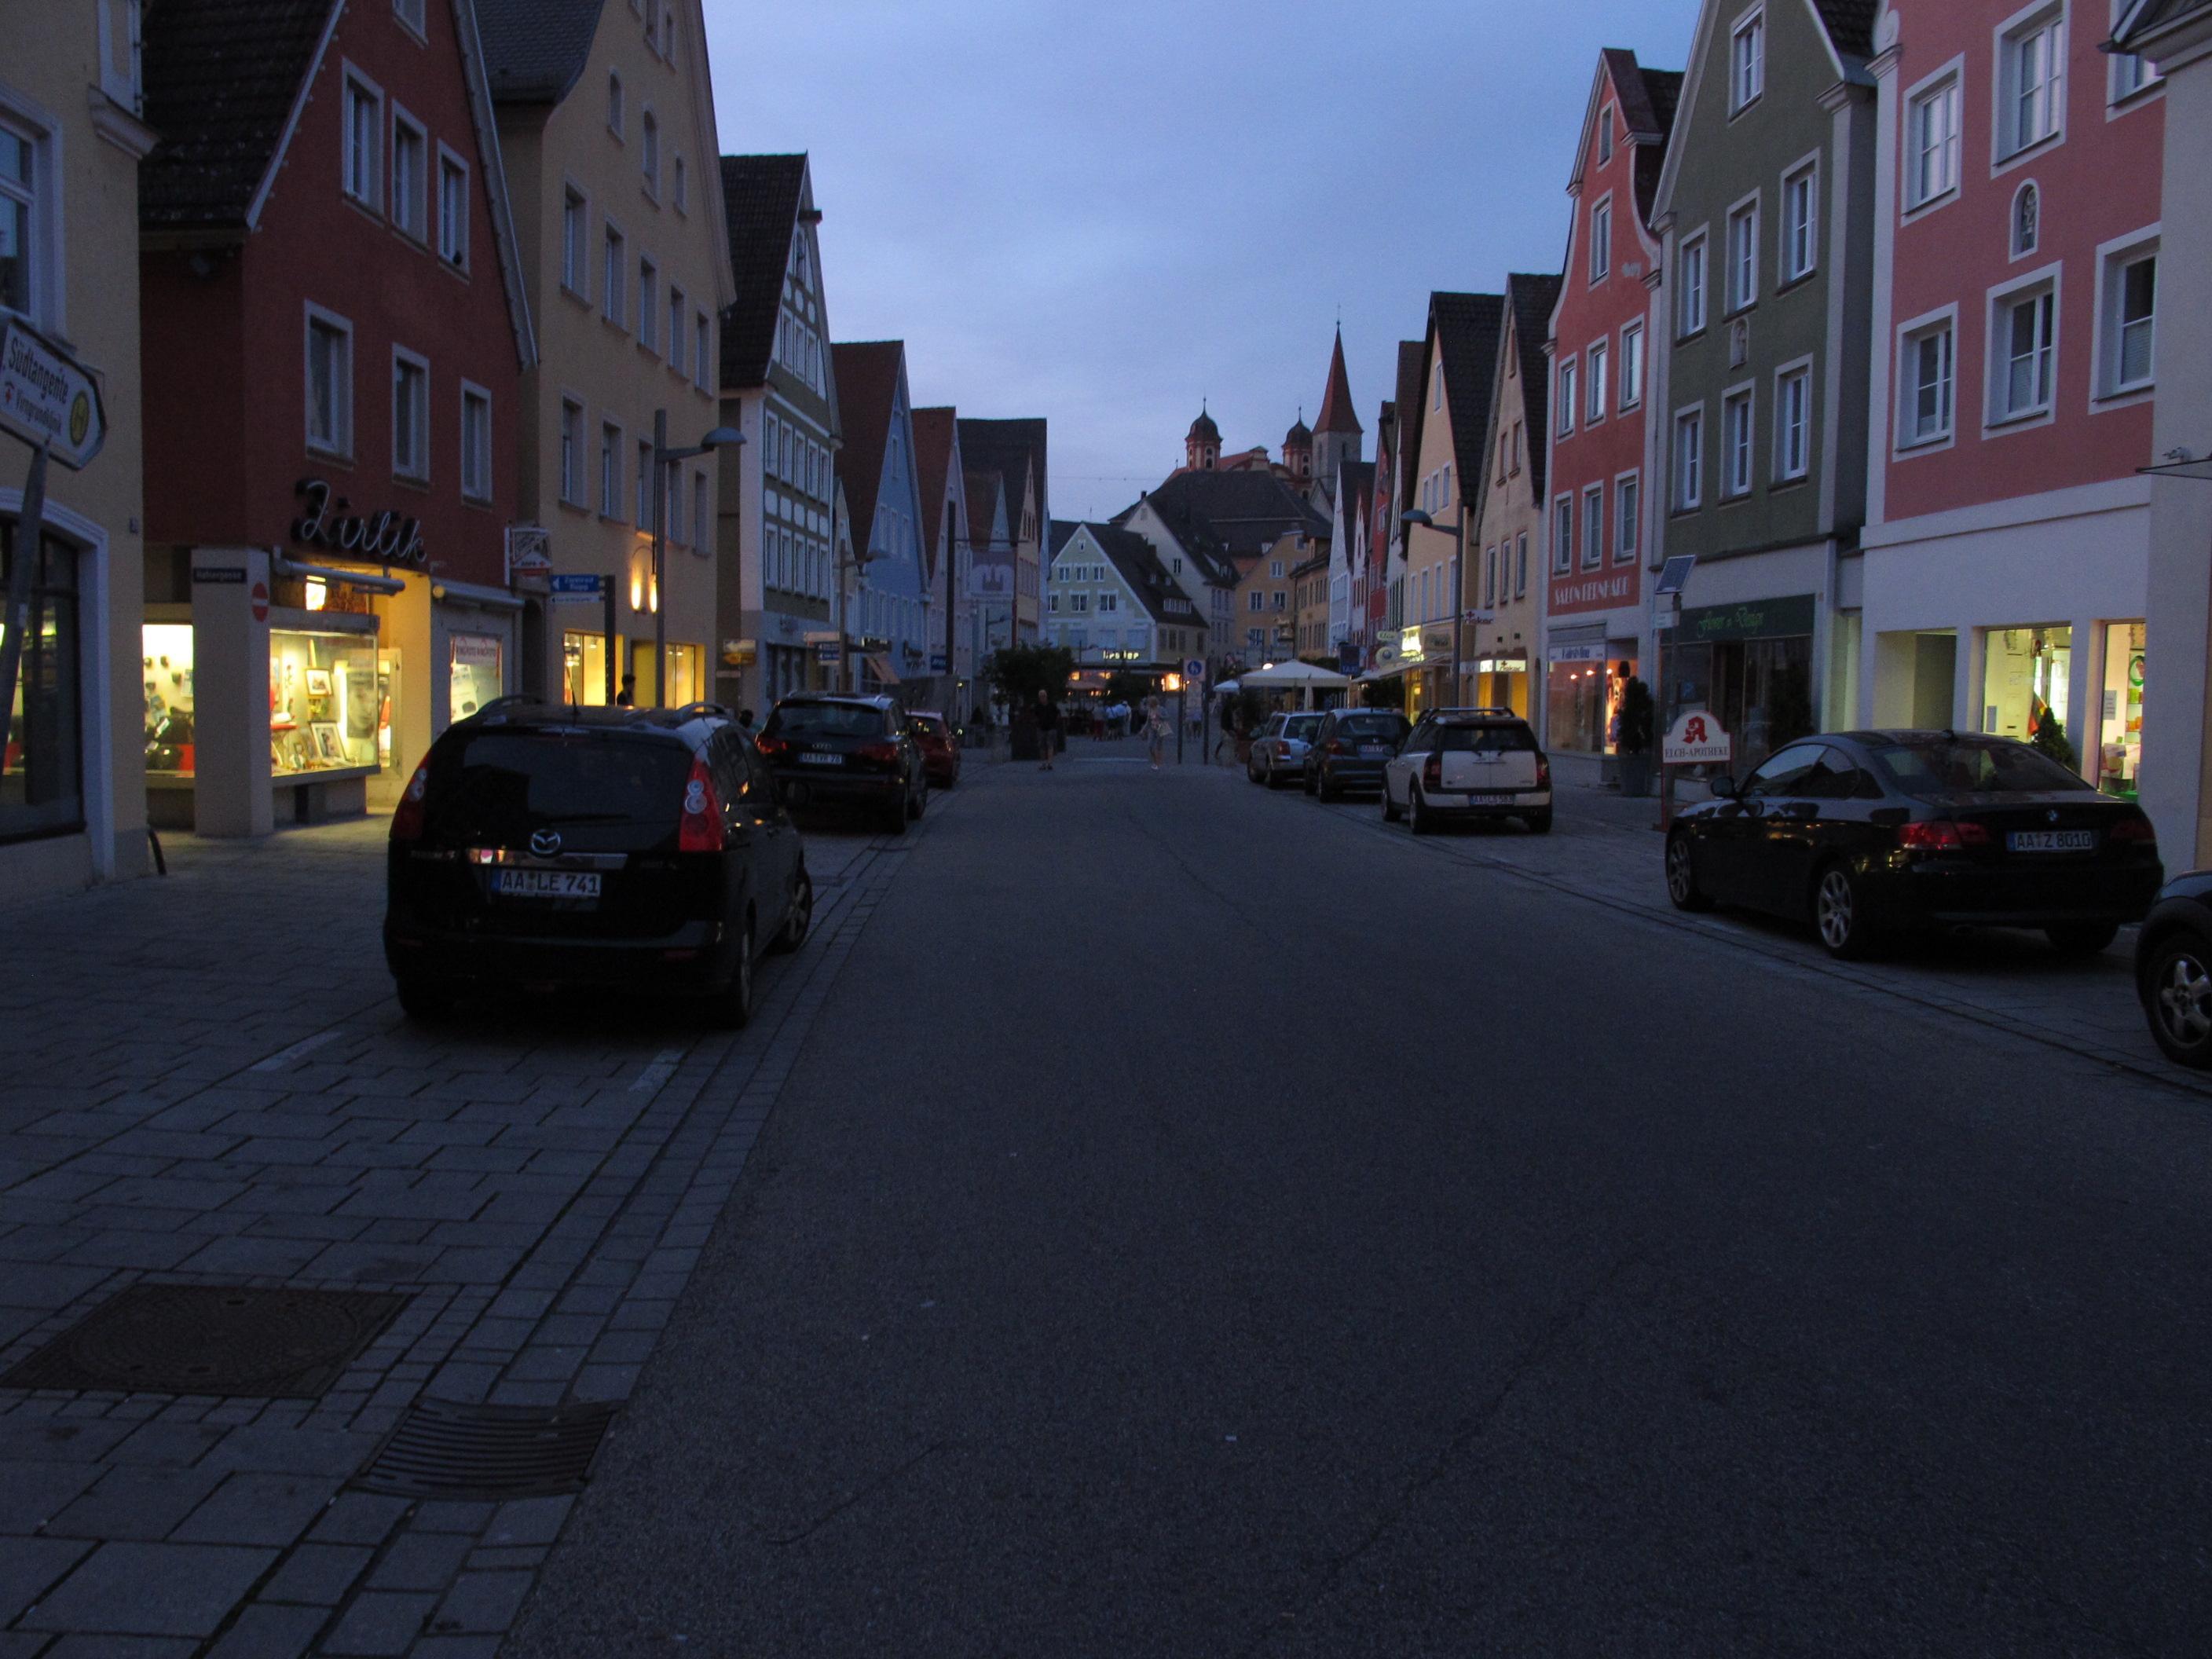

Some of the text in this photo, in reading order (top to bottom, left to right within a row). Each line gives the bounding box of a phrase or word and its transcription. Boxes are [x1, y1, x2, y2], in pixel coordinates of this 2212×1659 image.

[9, 337, 69, 405] Südtangente
[1664, 747, 1729, 758] ELCH-APOTHEKE
[2016, 833, 2090, 848] AA Z 8010
[502, 873, 599, 894] AA LE 741
